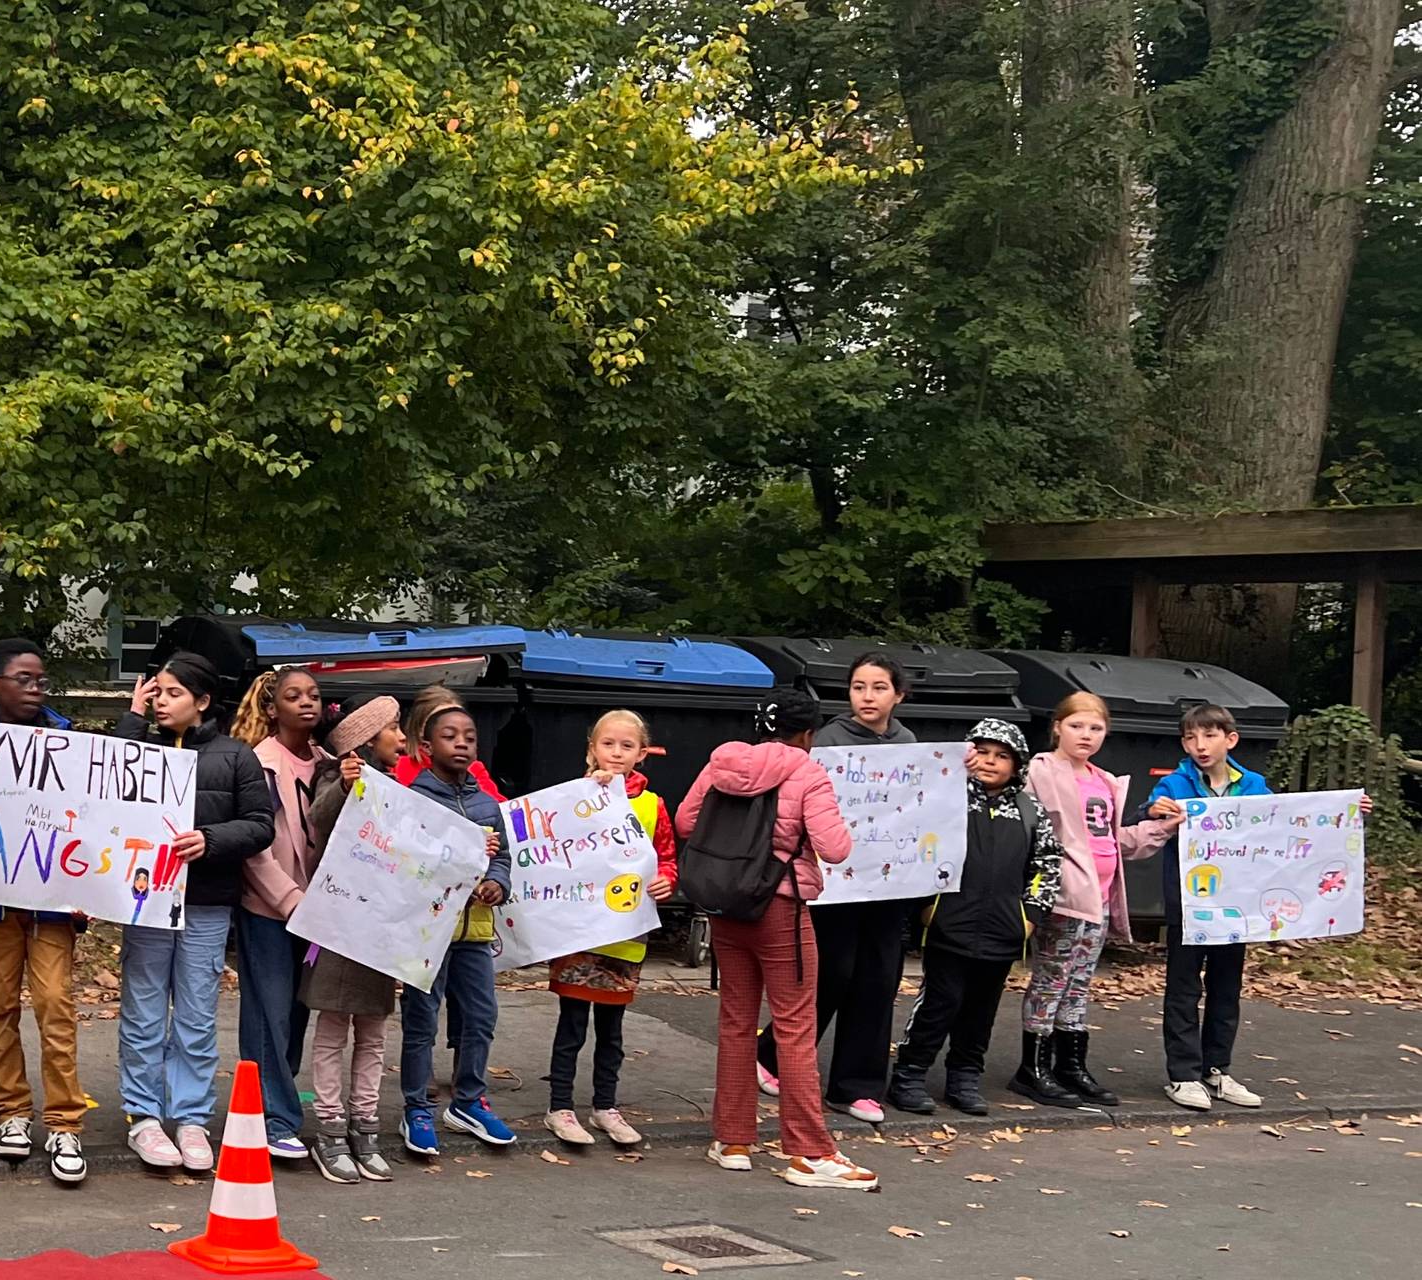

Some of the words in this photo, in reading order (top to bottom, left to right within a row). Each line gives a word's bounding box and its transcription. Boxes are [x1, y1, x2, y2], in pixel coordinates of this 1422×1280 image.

[86, 736, 197, 807] HABEN
[573, 784, 612, 818] auf
[1186, 800, 1243, 832] Passt
